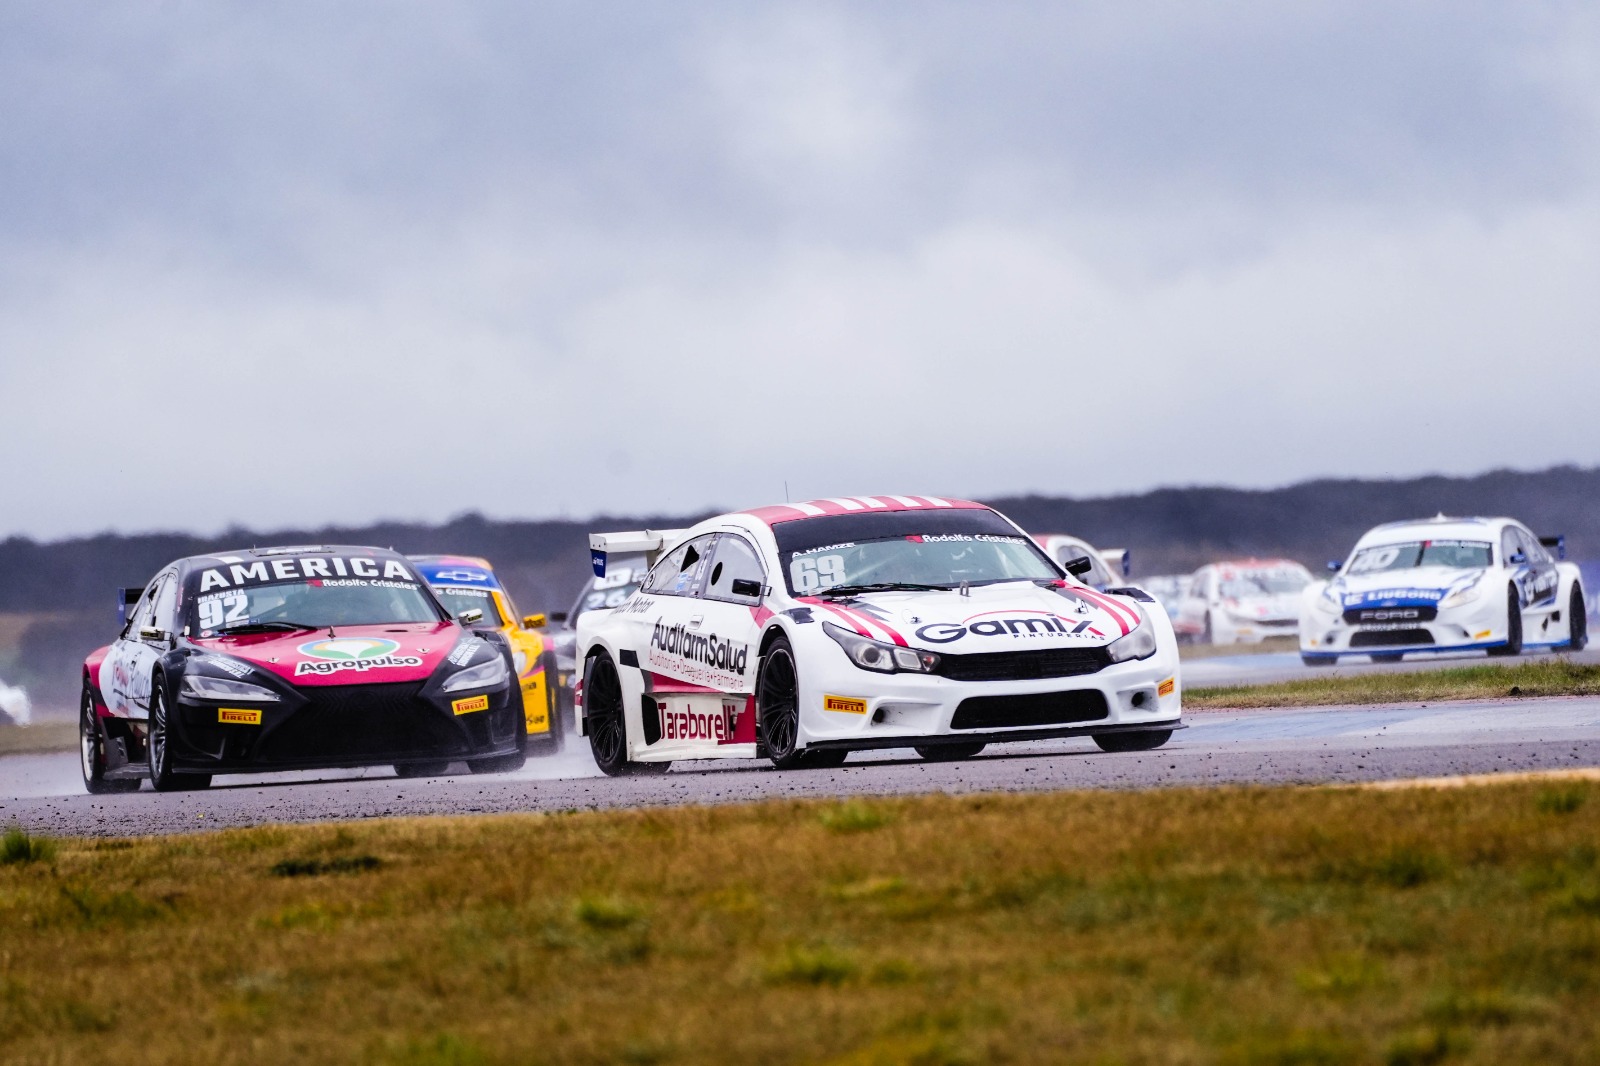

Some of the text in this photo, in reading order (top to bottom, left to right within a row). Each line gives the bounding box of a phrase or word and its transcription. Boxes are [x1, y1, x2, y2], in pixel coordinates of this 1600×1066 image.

[922, 533, 1027, 547] Rodolfo Cristales
[199, 557, 415, 592] AMERICA
[790, 554, 847, 593] 69
[322, 578, 418, 591] Rodolfo Cristales
[197, 589, 245, 603] IRAZUSTA
[446, 588, 488, 598] Cristales
[587, 588, 626, 609] 26
[198, 594, 250, 630] 92
[1360, 609, 1419, 620] FORD
[915, 612, 1105, 643] Gamix
[1013, 632, 1106, 641] PINTURERIAS
[650, 616, 748, 676] AudifarmSalud
[298, 656, 420, 674] Agropulso
[1158, 680, 1174, 696] PIRELLI
[456, 698, 486, 712] PIRELLI
[827, 698, 865, 713] PIRELLI
[221, 711, 257, 722] PIRELLI
[658, 702, 736, 740] Taraborelli
